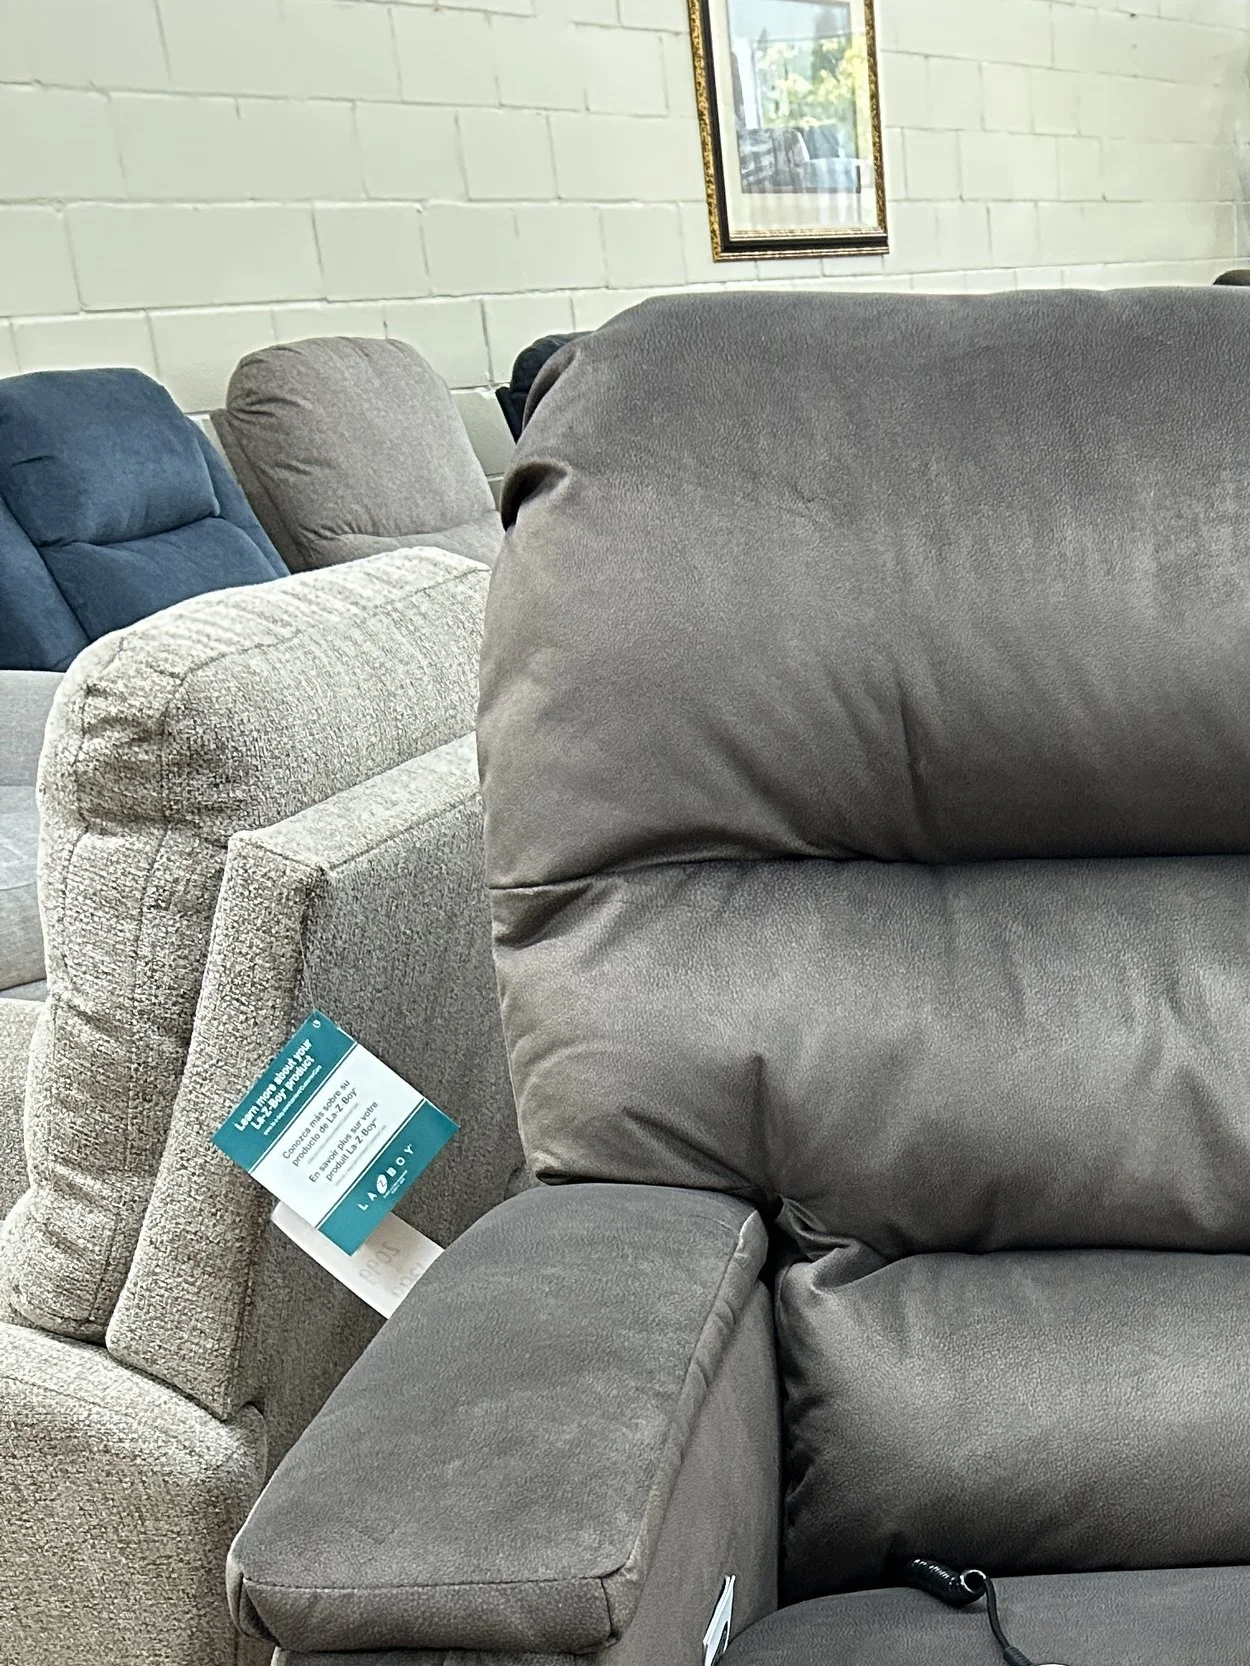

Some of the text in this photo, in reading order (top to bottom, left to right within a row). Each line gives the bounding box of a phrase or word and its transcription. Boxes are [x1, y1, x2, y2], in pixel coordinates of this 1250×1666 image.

[234, 1038, 312, 1131] Learn more about your
[284, 1055, 315, 1091] product
[282, 1080, 350, 1159] Conozca más sobre su
[292, 1133, 321, 1167] producto
[319, 1123, 329, 1133] de
[308, 1102, 378, 1183] En savoir plus sur votre
[326, 1154, 349, 1182] produit
